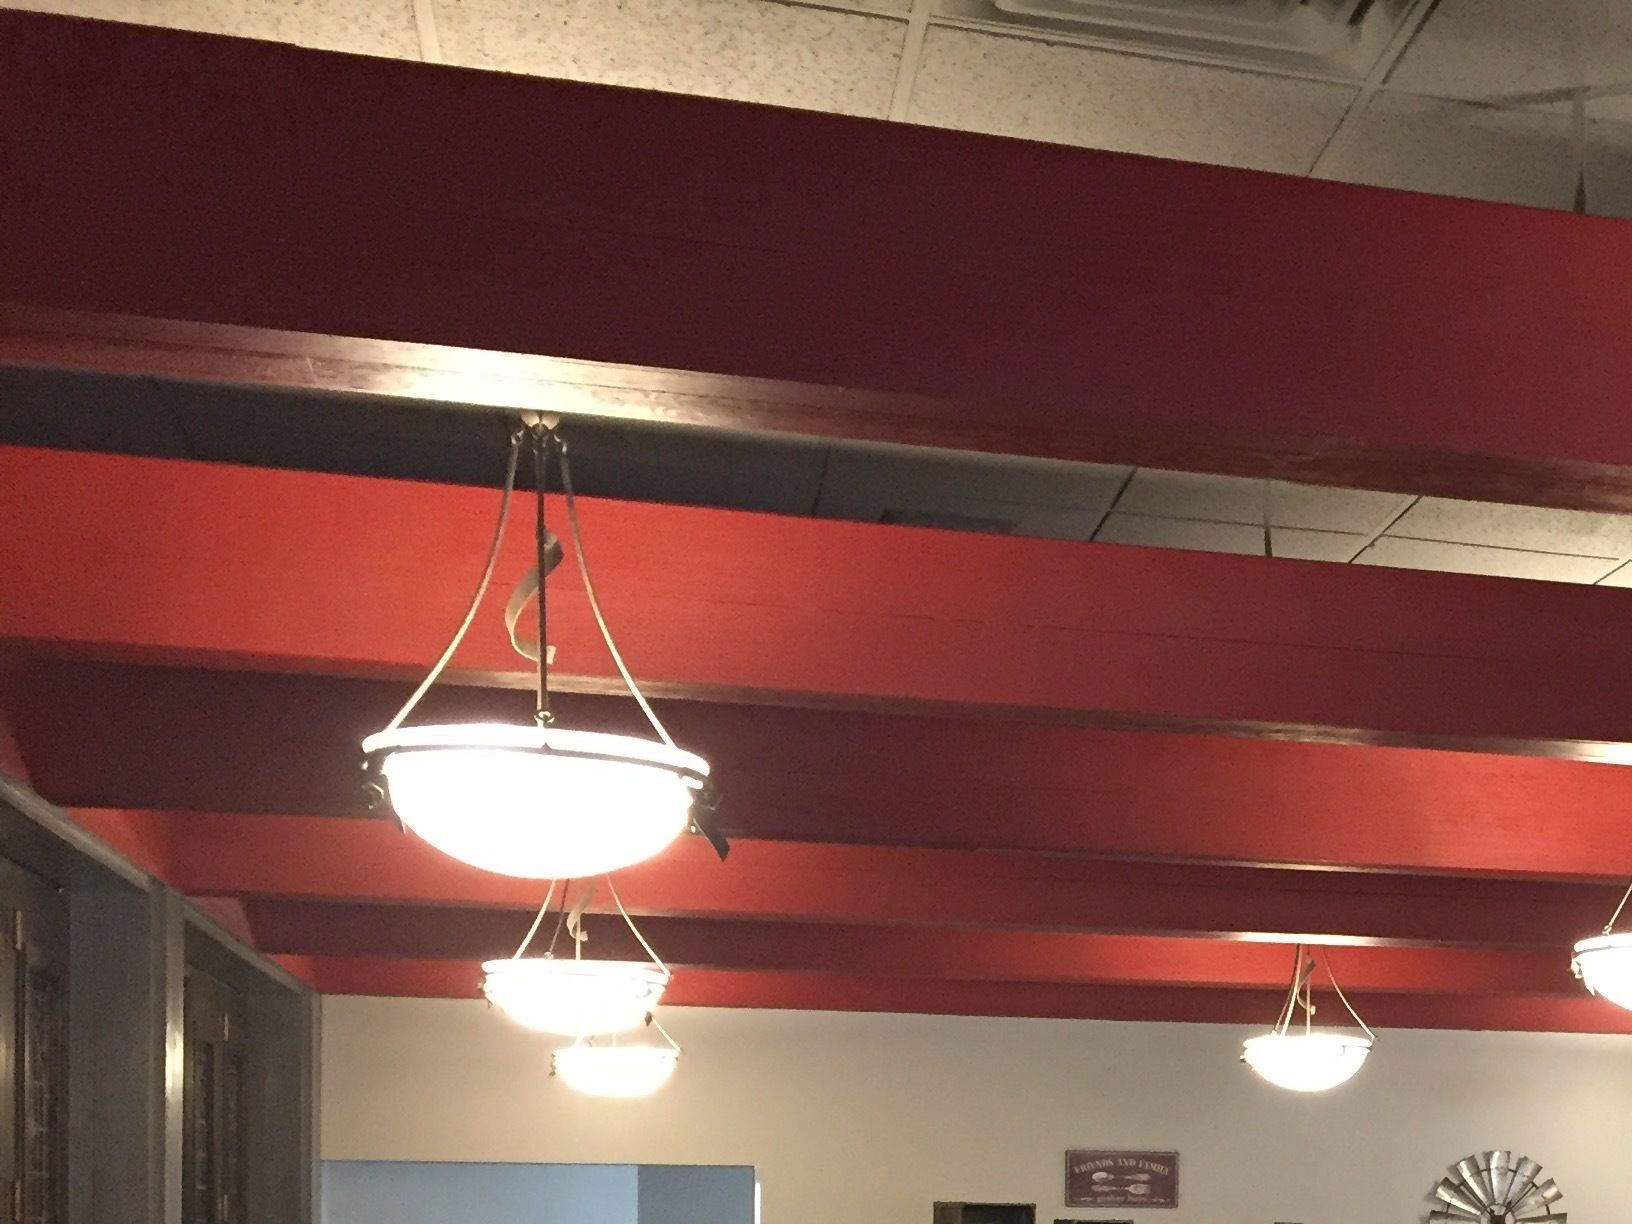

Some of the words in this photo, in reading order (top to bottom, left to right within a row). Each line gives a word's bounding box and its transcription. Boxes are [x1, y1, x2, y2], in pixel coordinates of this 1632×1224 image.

[1073, 1159, 1114, 1174] FRIENDS
[1118, 1158, 1136, 1167] AND
[1138, 1160, 1169, 1176] FAMILY
